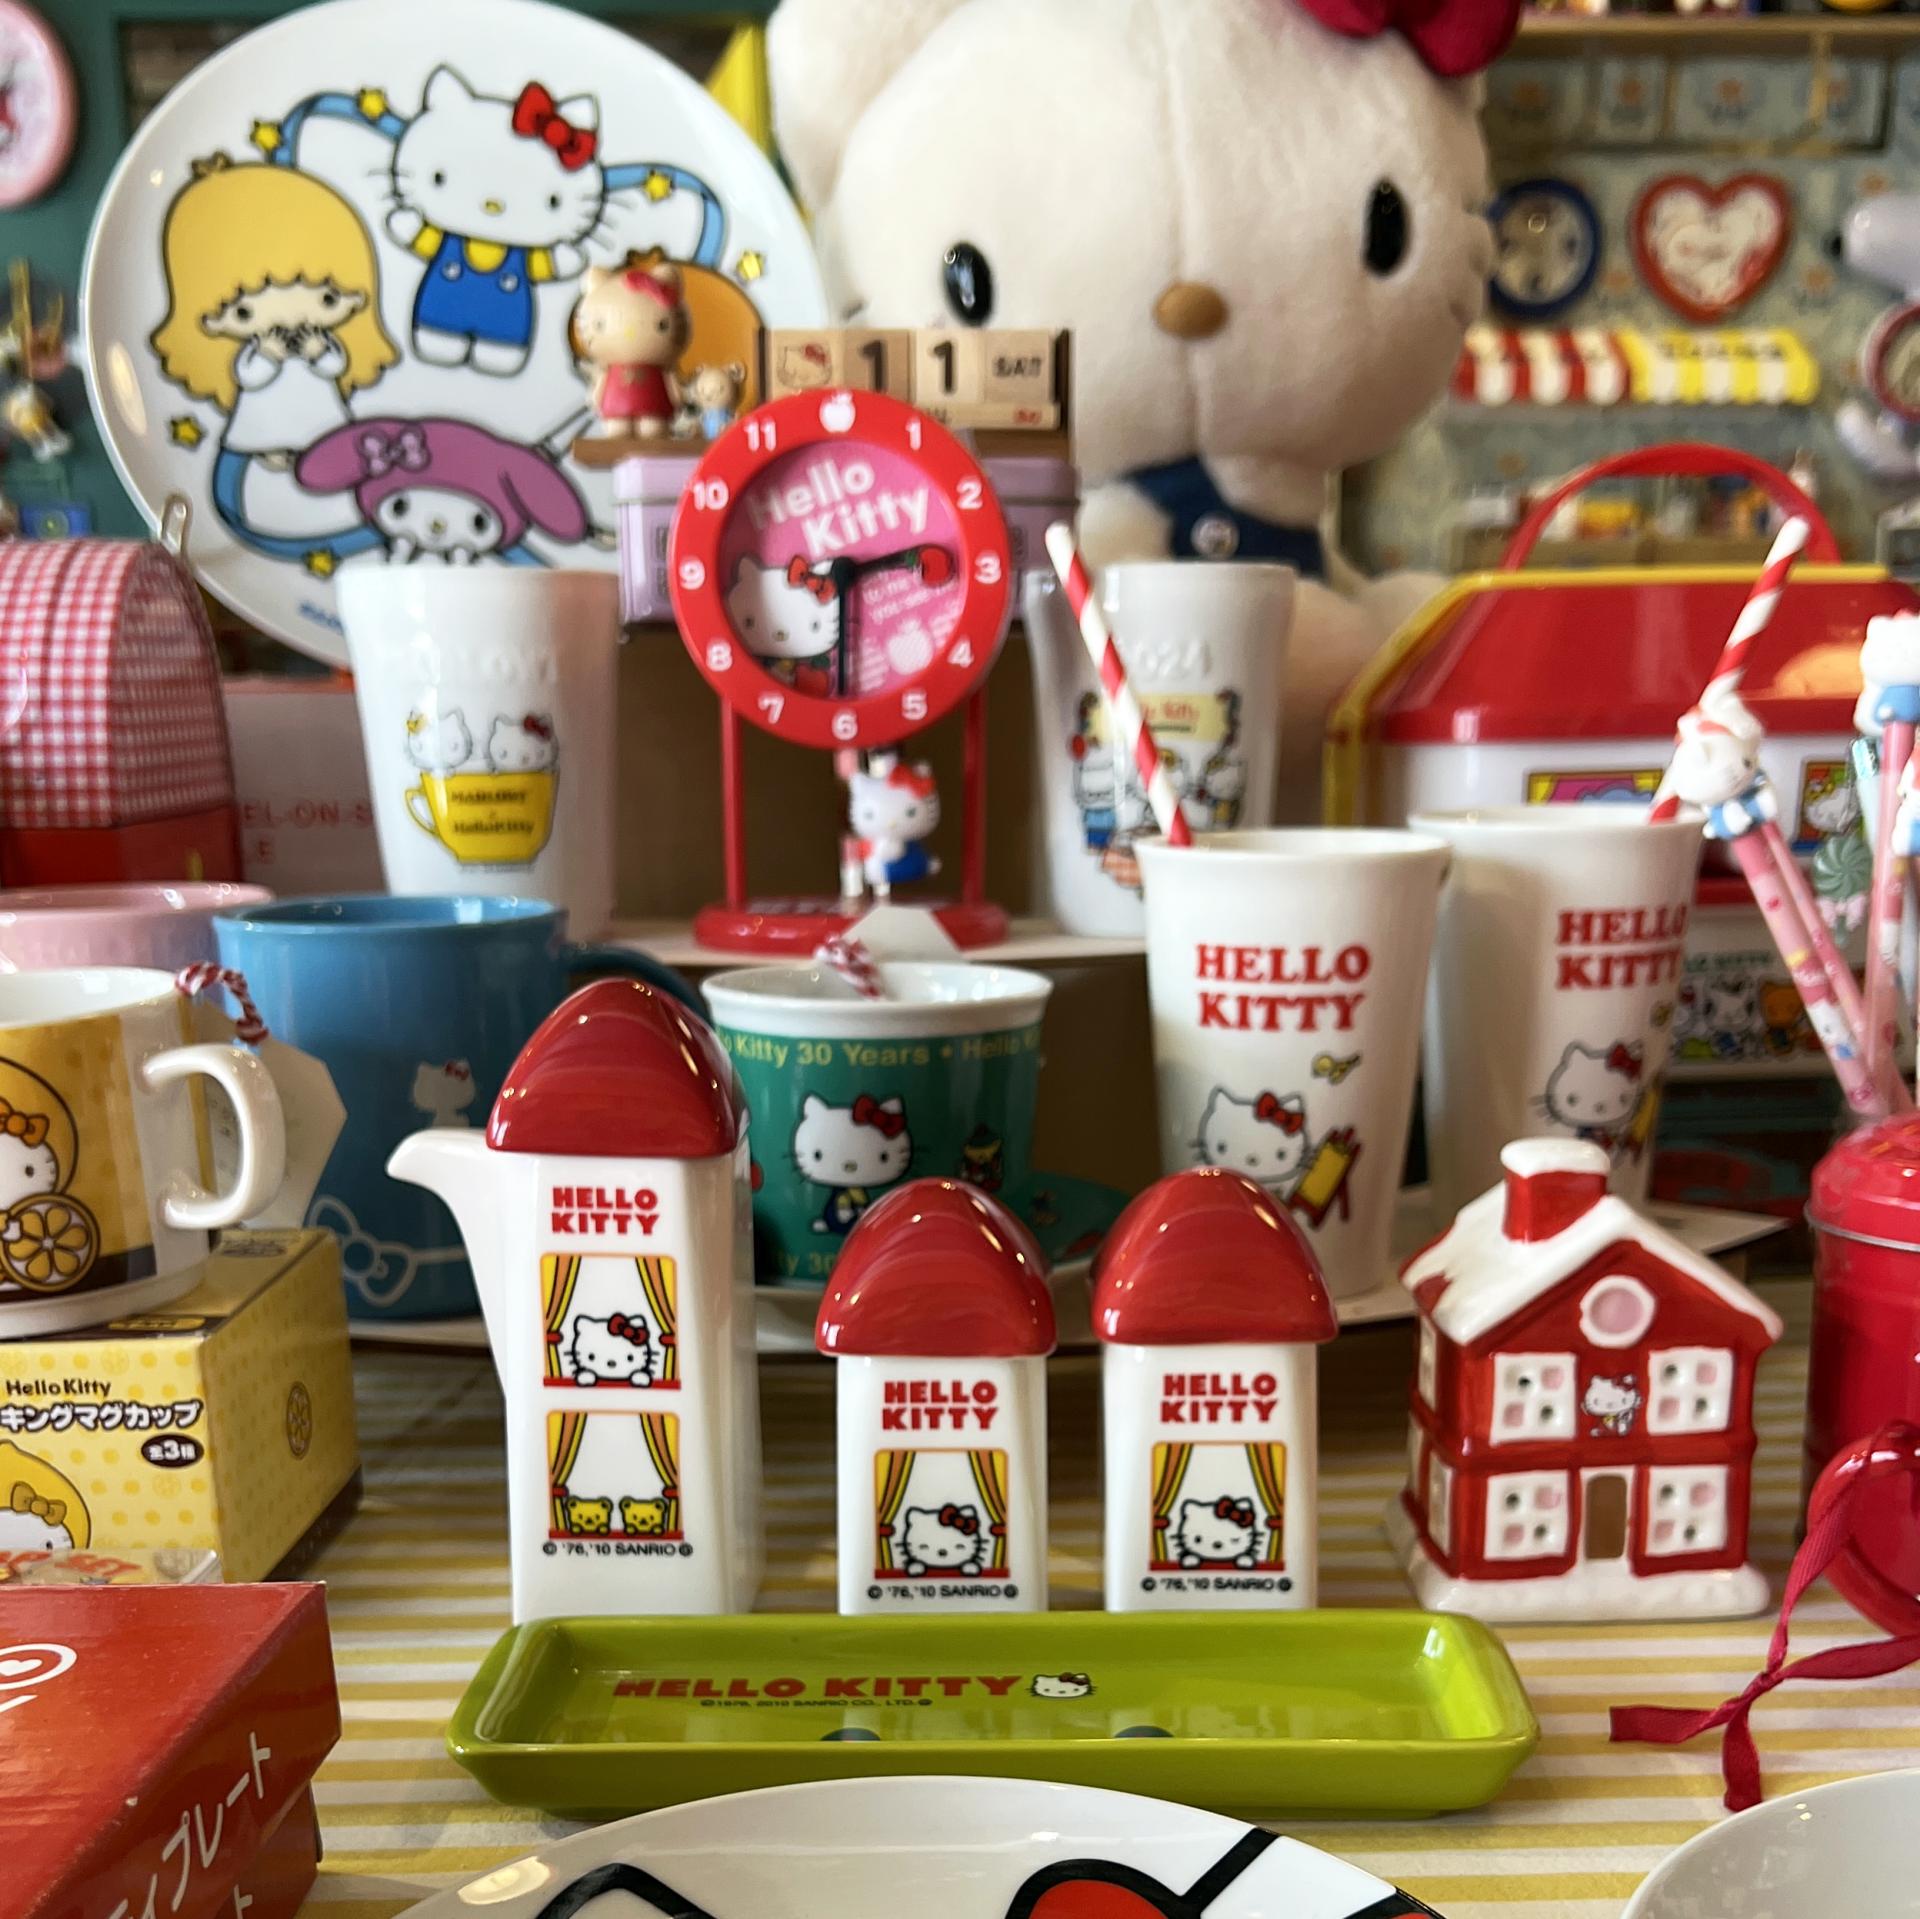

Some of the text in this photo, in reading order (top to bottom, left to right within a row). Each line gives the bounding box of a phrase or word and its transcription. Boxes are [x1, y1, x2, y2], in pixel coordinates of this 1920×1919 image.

[933, 340, 953, 394] 1
[744, 420, 778, 451] 11
[905, 419, 922, 450] 1
[692, 479, 730, 511] 10
[749, 459, 874, 530] Hello
[957, 477, 983, 510] 2
[802, 486, 929, 556] Kitty
[679, 557, 706, 590] 9
[975, 553, 1001, 584] 3
[706, 641, 733, 672] 8
[947, 637, 974, 668] 4
[758, 694, 785, 724] 7
[902, 690, 927, 720] 5
[832, 710, 858, 741] 6
[1196, 943, 1371, 984] HELLO
[1198, 992, 1365, 1031] KITTY
[736, 1033, 788, 1069] Kitty
[797, 1041, 832, 1065] 30
[843, 1044, 929, 1067] Years
[552, 1187, 659, 1210] HELLO
[551, 1212, 659, 1235] KITTY
[884, 1380, 998, 1404] HELLO
[1163, 1373, 1278, 1397] HELLO
[881, 1407, 999, 1430] KITTY
[1161, 1400, 1279, 1423] KITTY
[615, 1543, 677, 1557] SANRIO
[940, 1584, 1001, 1598] SANRIO
[1214, 1577, 1275, 1591] SANRIO
[613, 1675, 1023, 1698] HELLO KITTY
